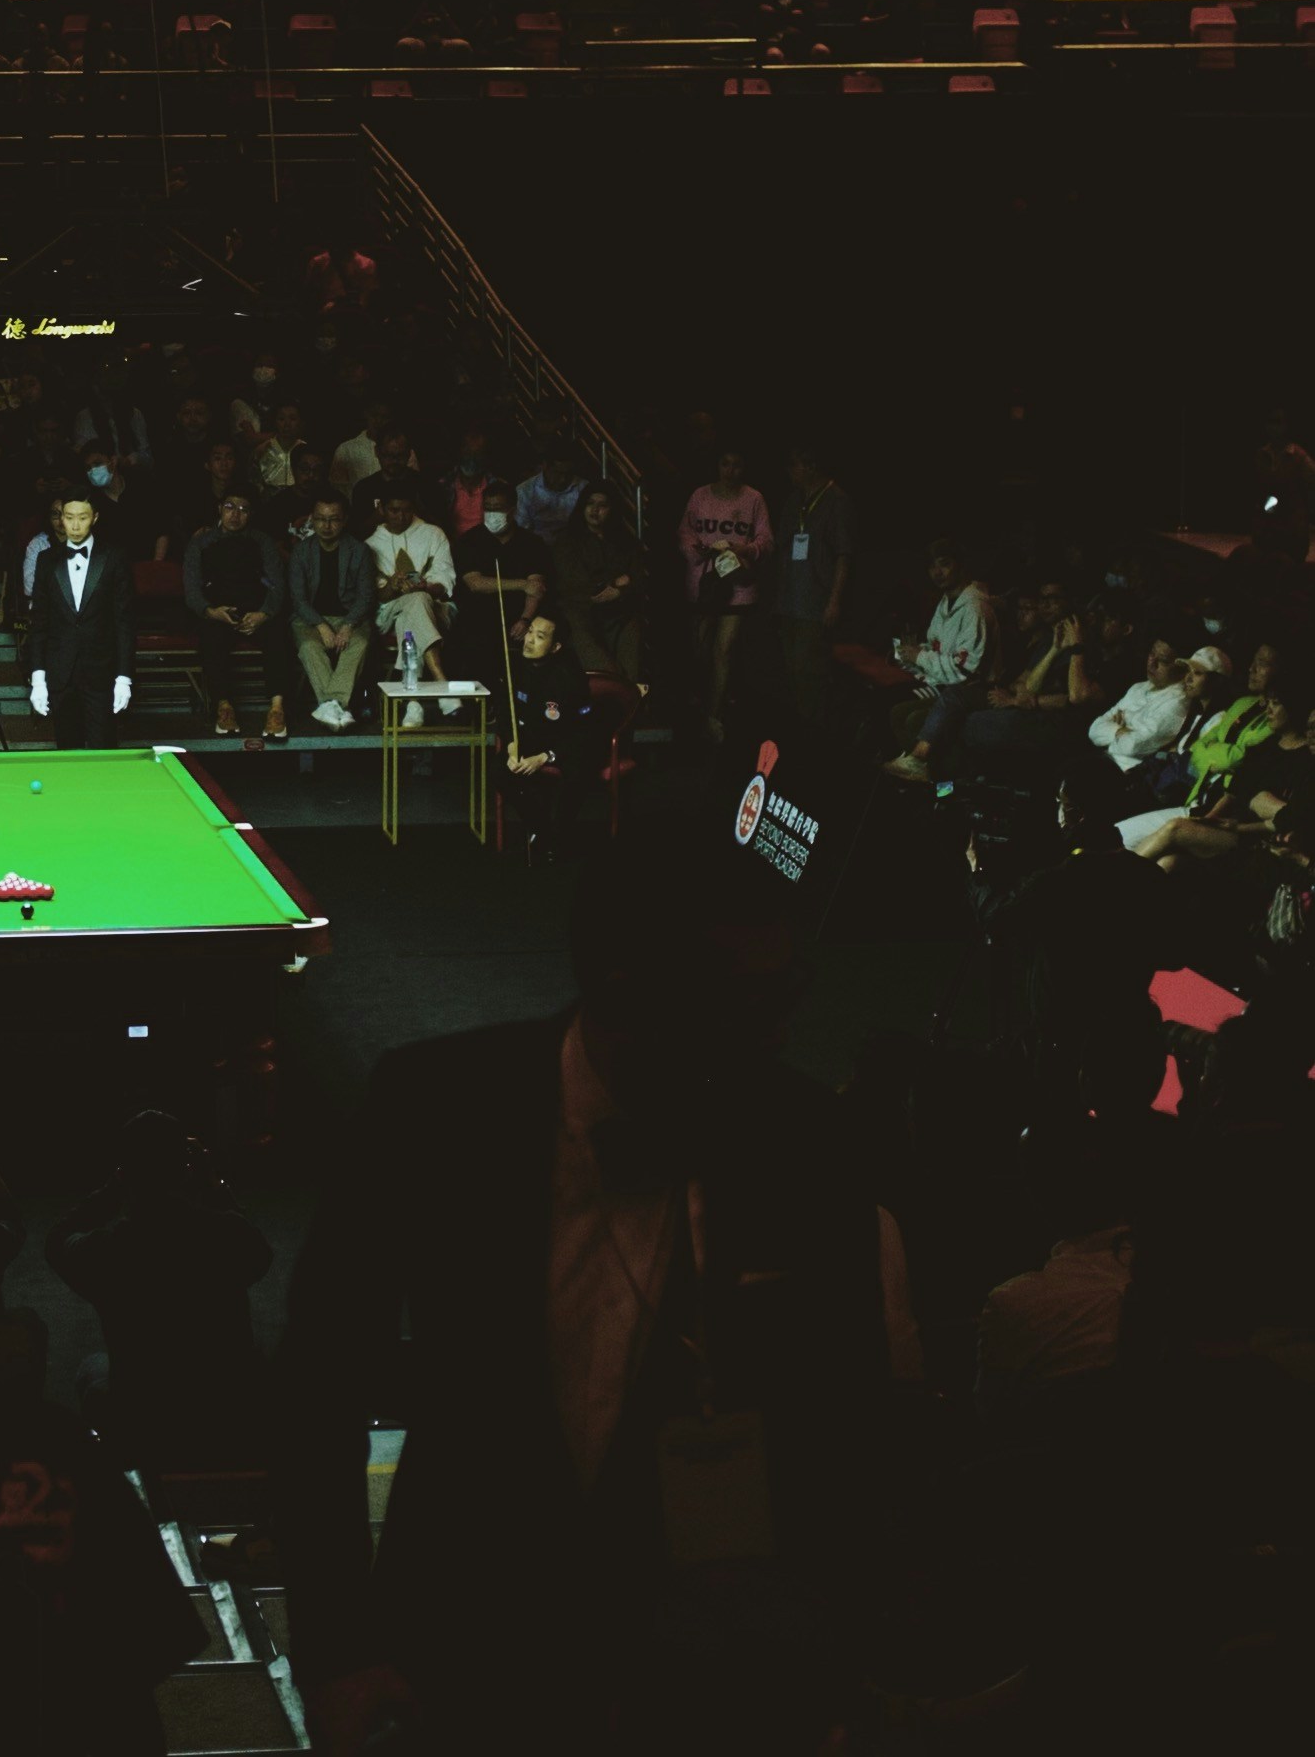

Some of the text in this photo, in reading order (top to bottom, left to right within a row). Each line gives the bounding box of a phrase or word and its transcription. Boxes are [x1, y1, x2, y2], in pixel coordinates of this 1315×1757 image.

[694, 519, 756, 539] GUCCI
[753, 834, 804, 884] SPORTS ACADEMY
[758, 817, 810, 867] BEYOND BORDERS
